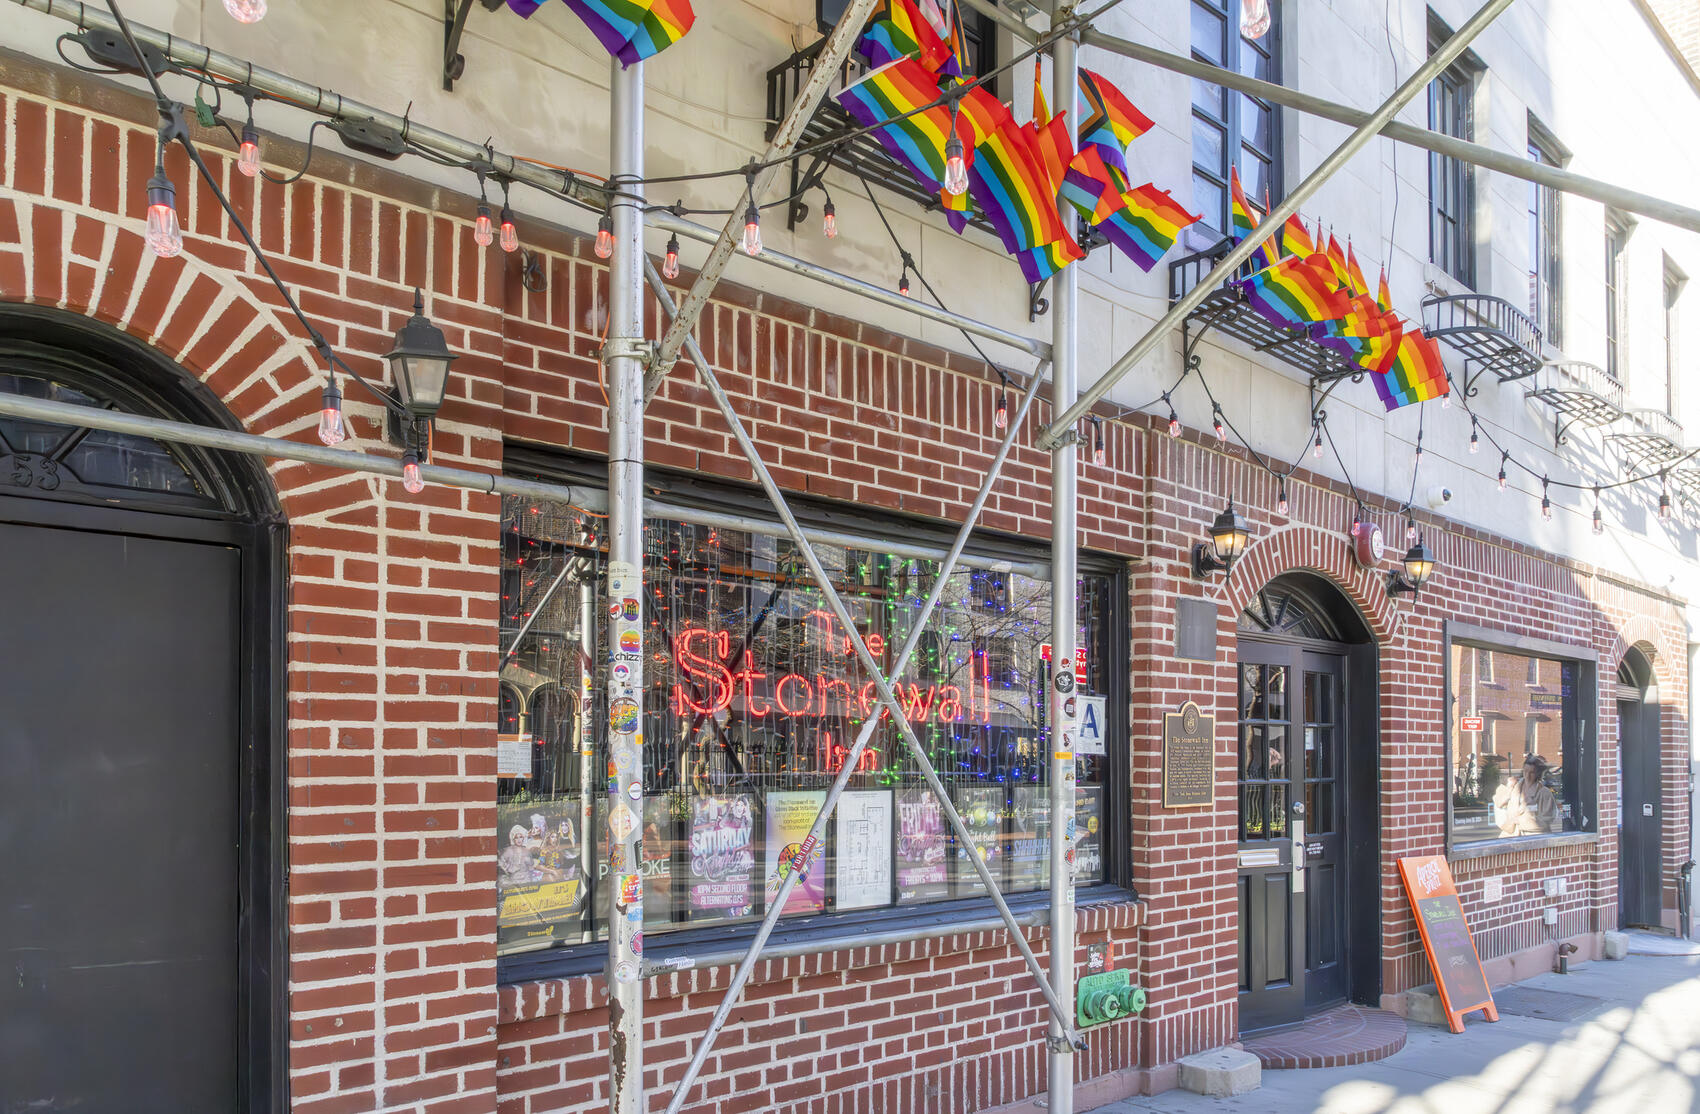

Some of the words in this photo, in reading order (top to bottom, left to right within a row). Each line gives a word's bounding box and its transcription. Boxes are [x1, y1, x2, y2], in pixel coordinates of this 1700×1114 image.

[10, 453, 61, 491] 53
[672, 628, 990, 723] Stonewall
[1080, 703, 1099, 738] A
[692, 826, 752, 857] SATURDAY
[700, 895, 732, 905] ALTERNATING
[711, 883, 731, 893] SECOND
[731, 883, 748, 893] FLOOR
